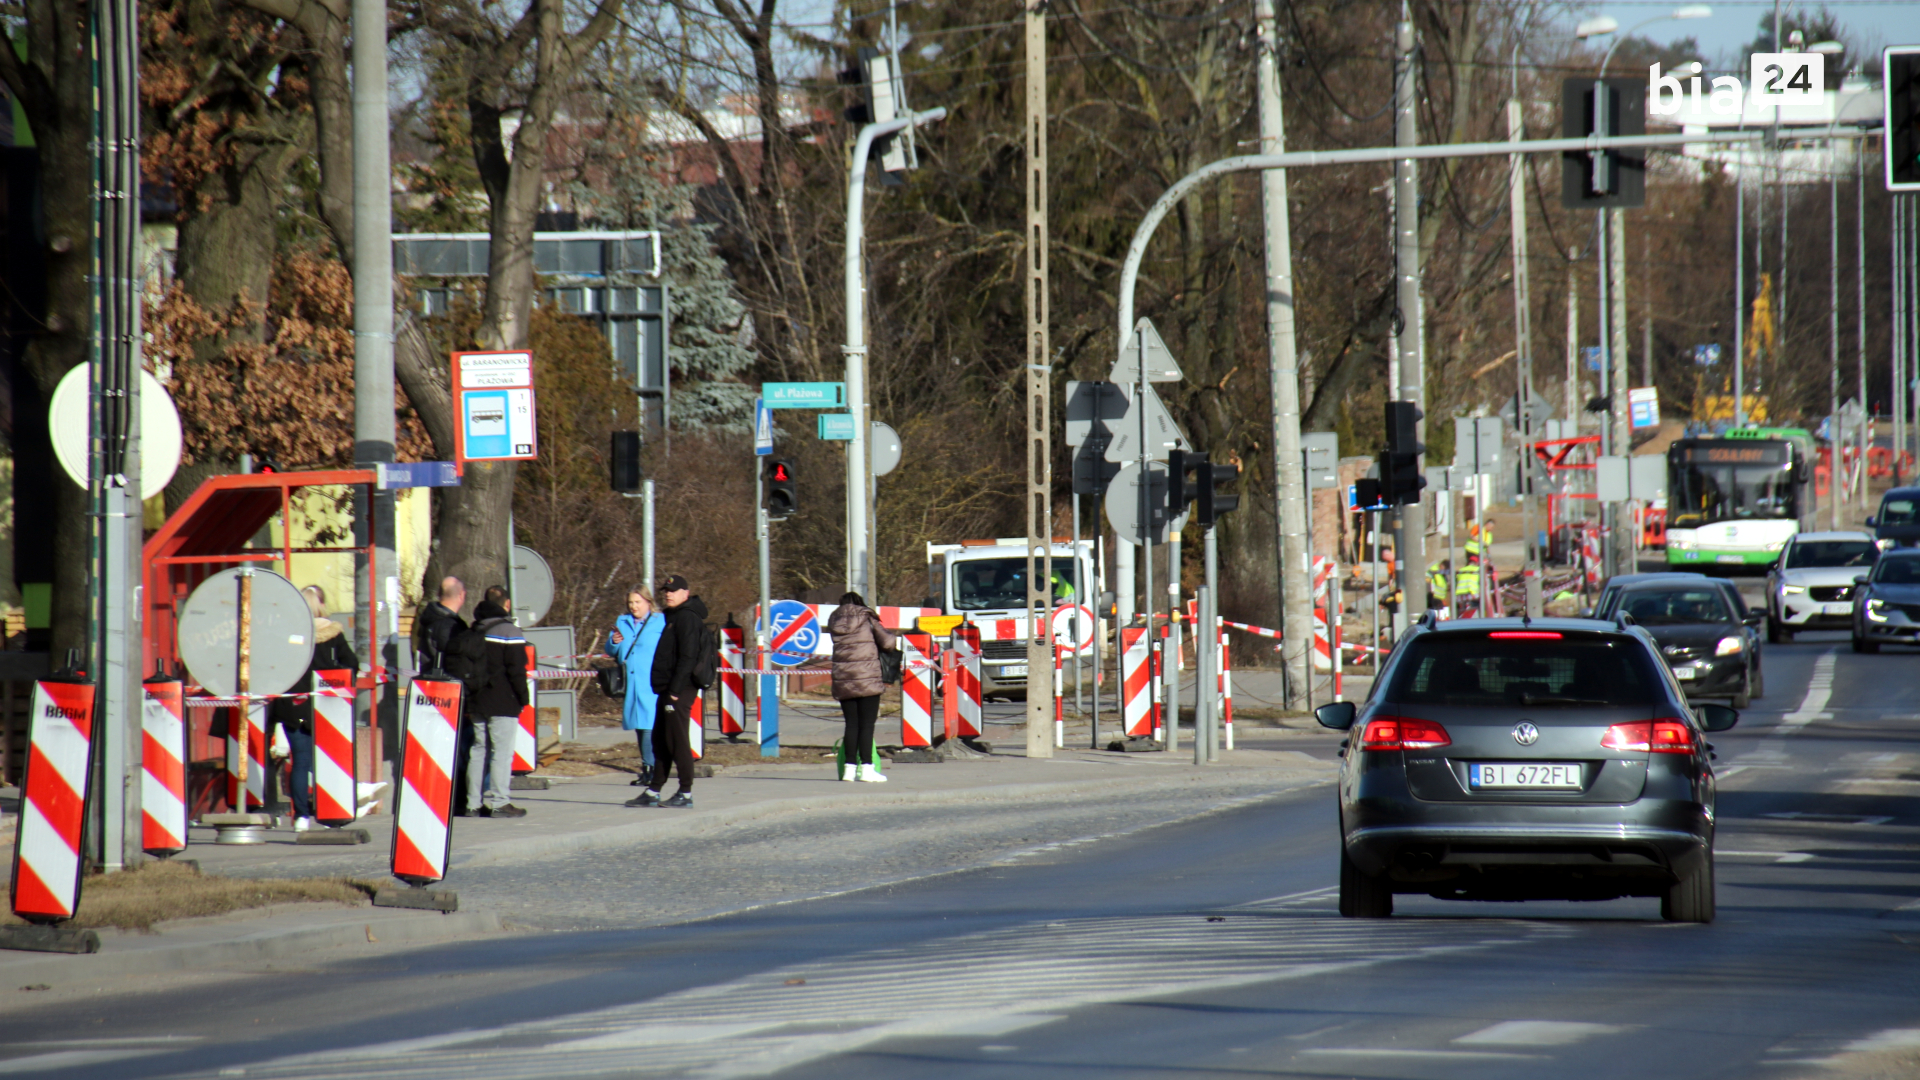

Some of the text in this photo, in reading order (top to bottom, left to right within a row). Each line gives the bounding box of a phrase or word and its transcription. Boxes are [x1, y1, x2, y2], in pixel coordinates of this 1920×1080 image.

[473, 357, 528, 366] BARANOWICKA
[774, 387, 823, 398] ul. Plażowa
[517, 406, 527, 414] 15
[417, 694, 451, 709] BBGM
[45, 705, 87, 720] BBGM
[1484, 766, 1576, 785] BI 672FL
